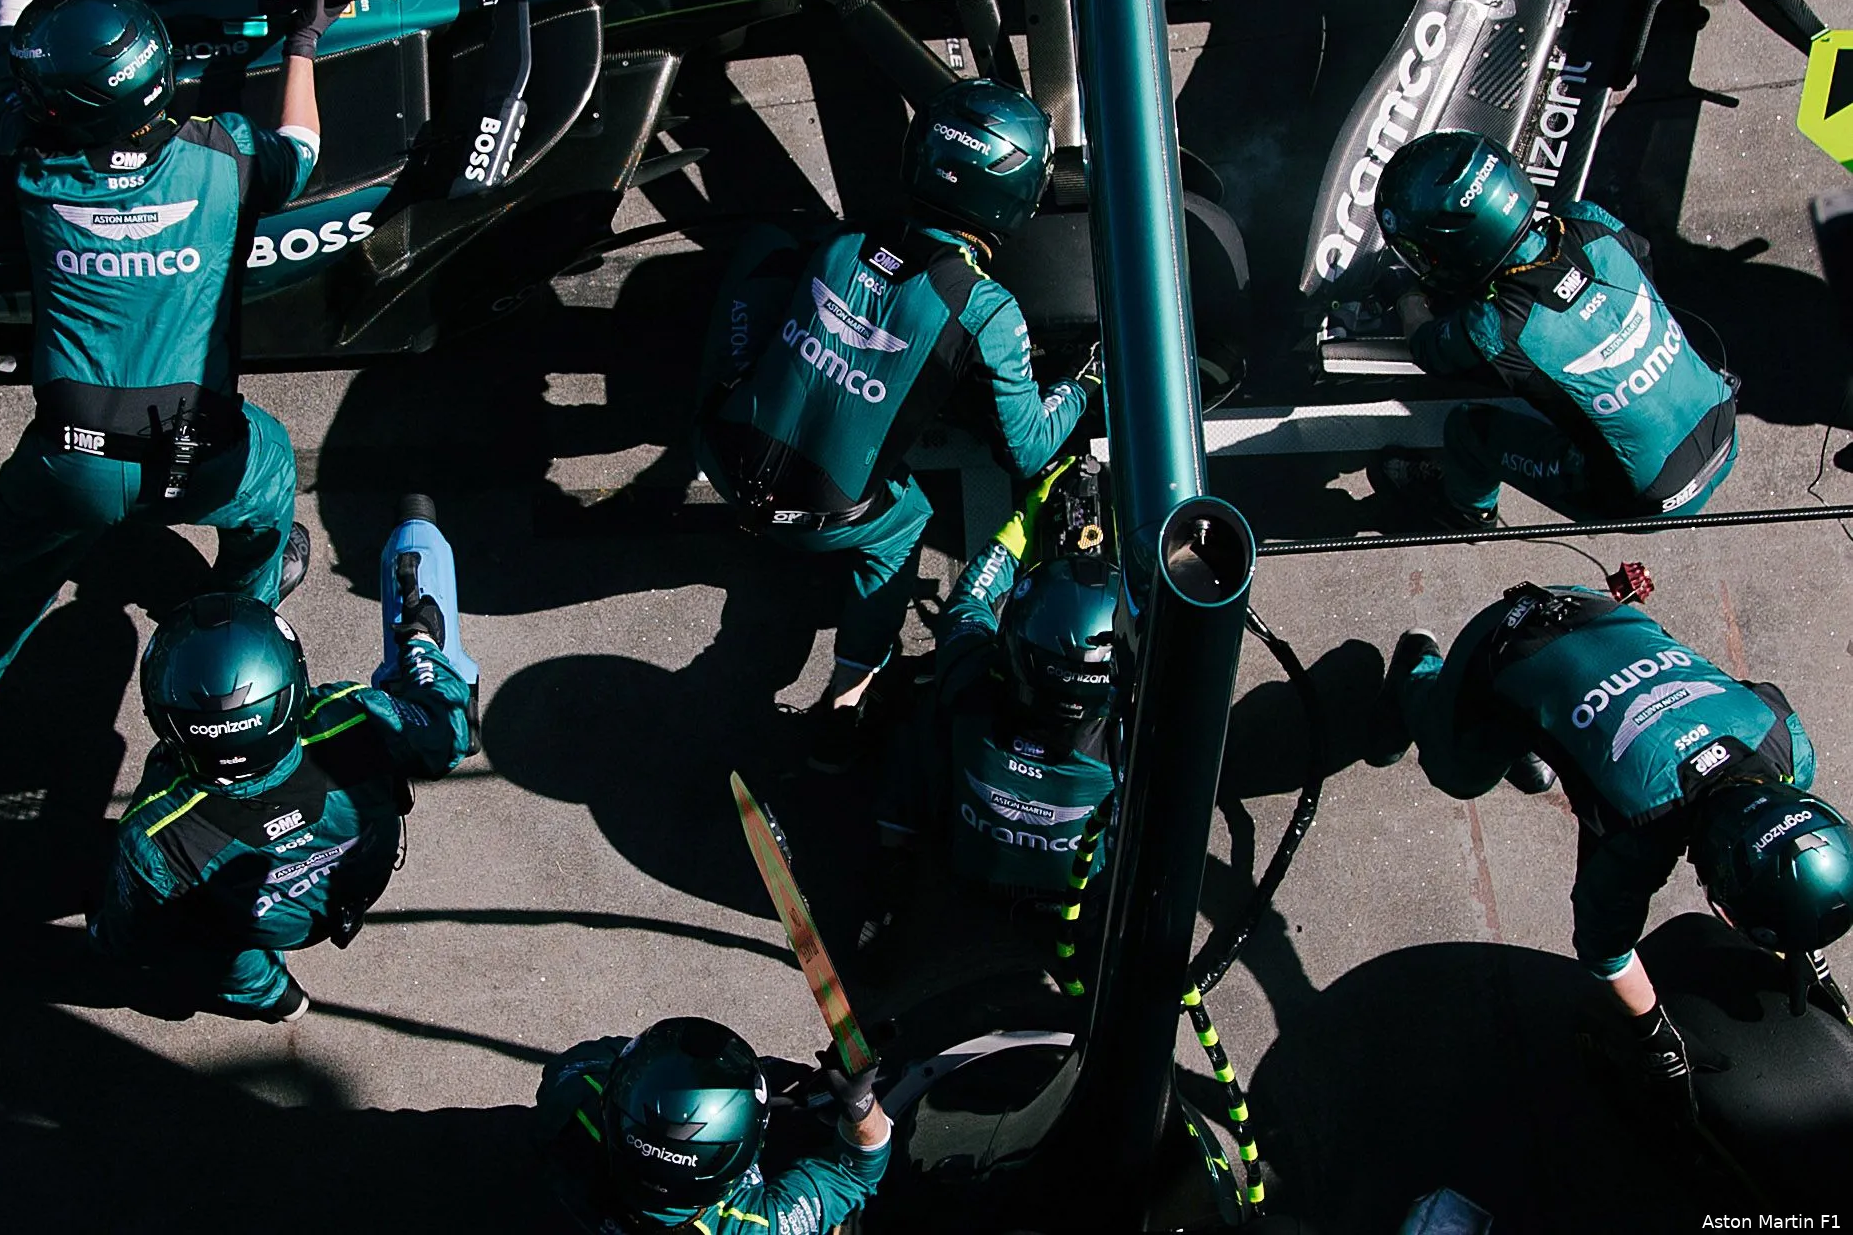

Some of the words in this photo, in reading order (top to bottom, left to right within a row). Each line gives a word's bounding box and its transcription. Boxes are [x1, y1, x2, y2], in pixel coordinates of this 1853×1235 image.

[106, 38, 160, 88] cognizant
[465, 116, 503, 182] BOSS
[932, 121, 992, 157] cognizant
[1315, 11, 1447, 282] aramco
[110, 151, 149, 169] OMP
[107, 175, 146, 190] BOSS
[1459, 154, 1500, 210] cognizant
[93, 214, 123, 224] ASTON
[124, 213, 158, 223] MARTIN
[247, 210, 375, 269] BOSS
[55, 247, 201, 277] aramco
[873, 248, 904, 274] OMP
[857, 270, 885, 297] BOSS
[1557, 267, 1589, 302] OMP
[1579, 291, 1607, 321] BOSS
[782, 319, 887, 405] aramco
[1593, 320, 1681, 419] aramco
[1571, 648, 1693, 729] aramco
[188, 714, 264, 738] cognizant
[1673, 723, 1710, 752] BOSS
[1008, 759, 1043, 779] BOSS
[1693, 743, 1732, 776] OMP
[993, 794, 1020, 809] ASTON
[1020, 801, 1053, 818] MARTIN
[265, 811, 304, 840] OMP
[1751, 809, 1814, 853] cognizant
[274, 832, 314, 855] BOSS
[626, 1133, 699, 1168] cognizant
